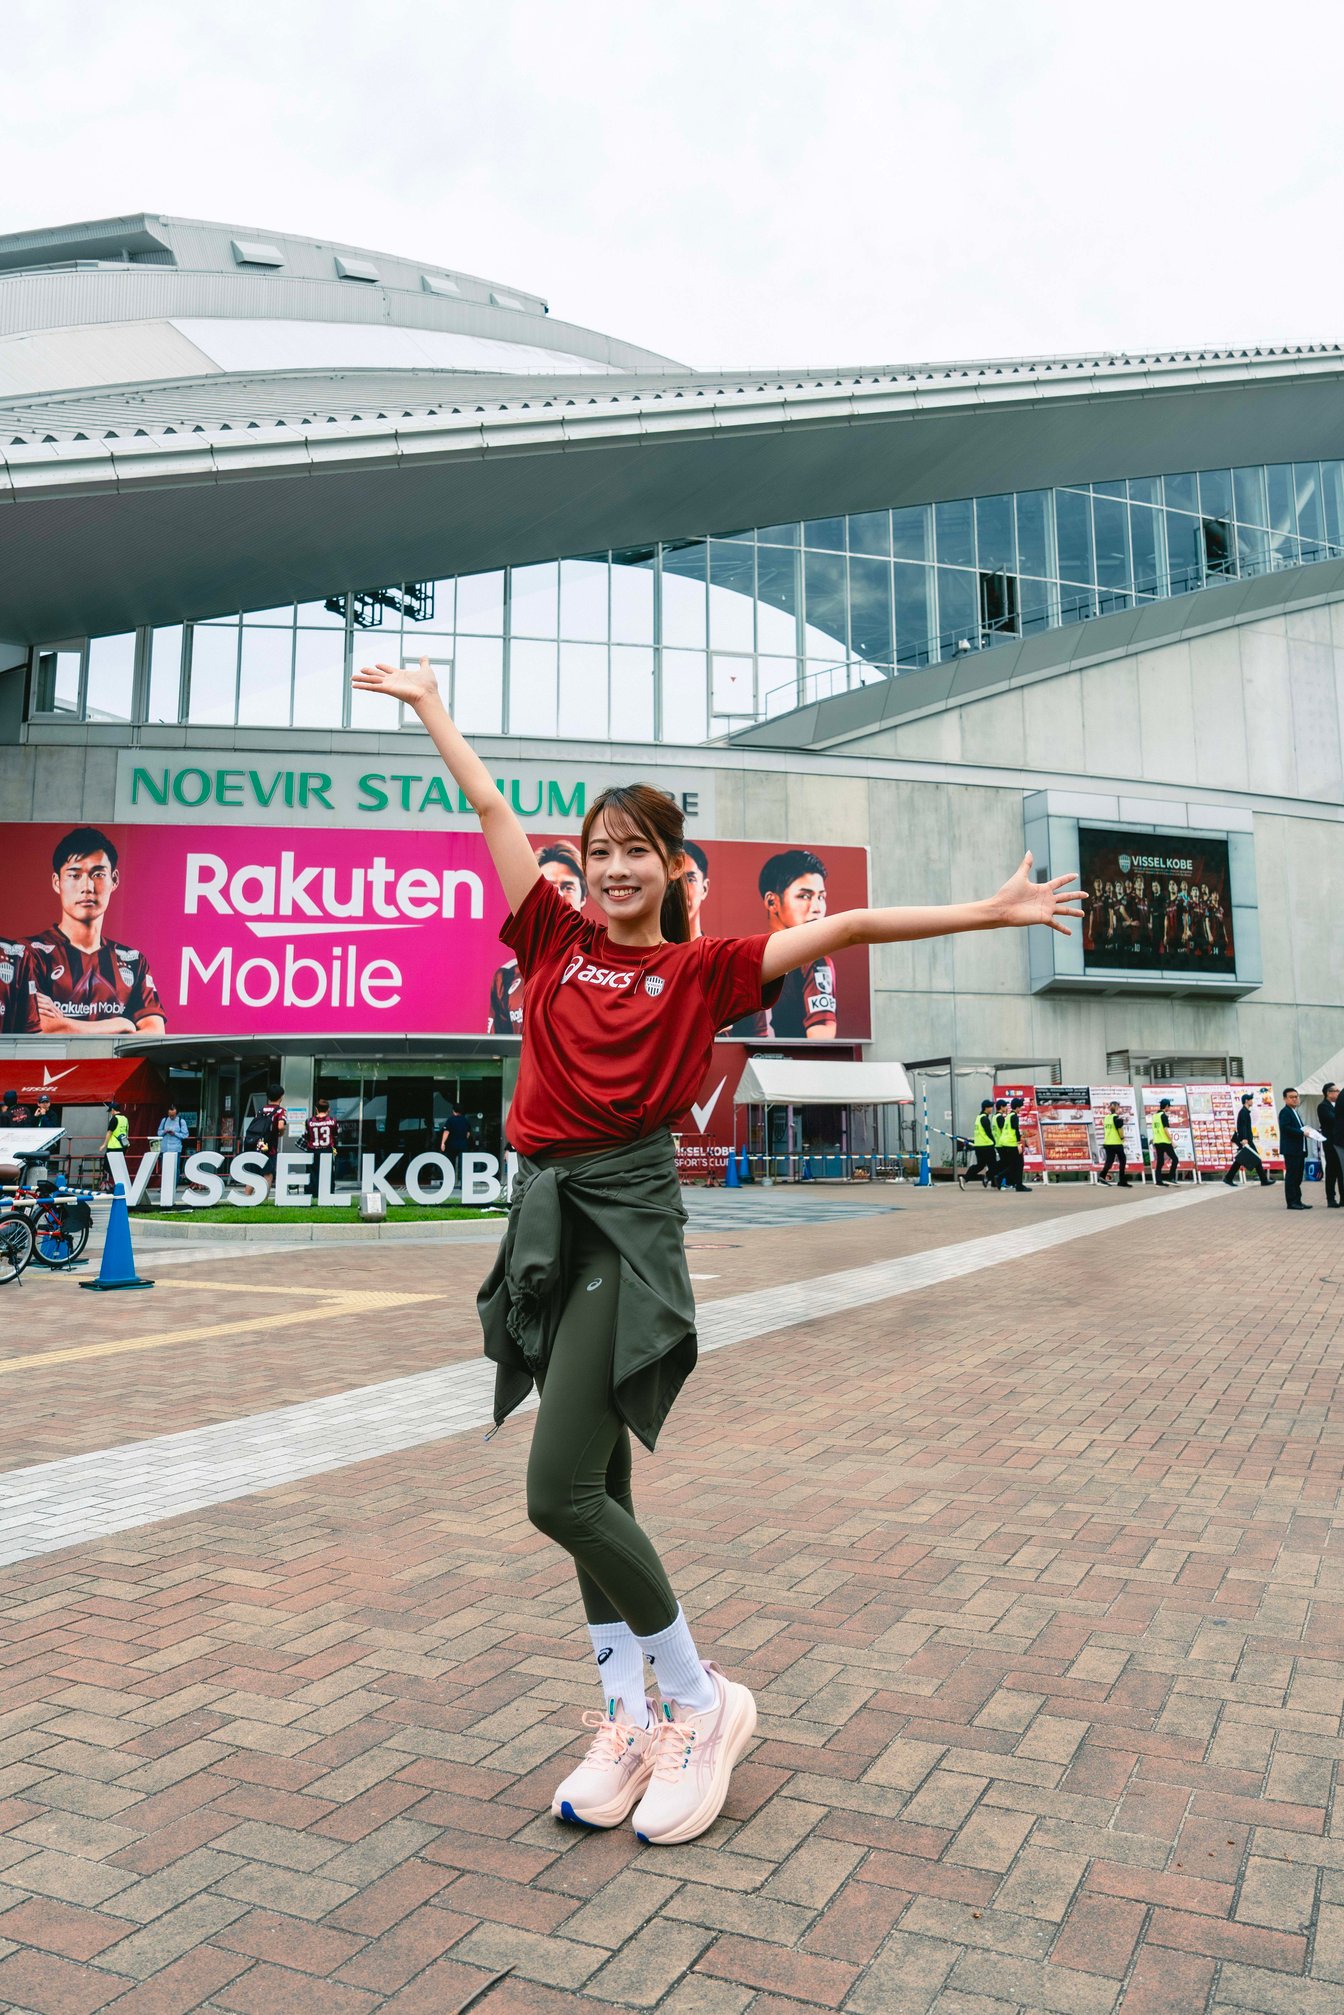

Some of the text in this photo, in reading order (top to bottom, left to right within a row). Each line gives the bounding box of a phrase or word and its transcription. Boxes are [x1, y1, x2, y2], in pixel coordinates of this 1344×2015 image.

[131, 768, 335, 809] NOEVIR
[1131, 855, 1193, 870] VISSEL KOBE
[184, 851, 484, 919] Rakuten
[179, 944, 404, 1009] Mobile
[577, 964, 635, 988] asics
[313, 1126, 330, 1147] 13
[709, 1158, 729, 1167] CLU
[106, 1151, 352, 1207] VISSEL
